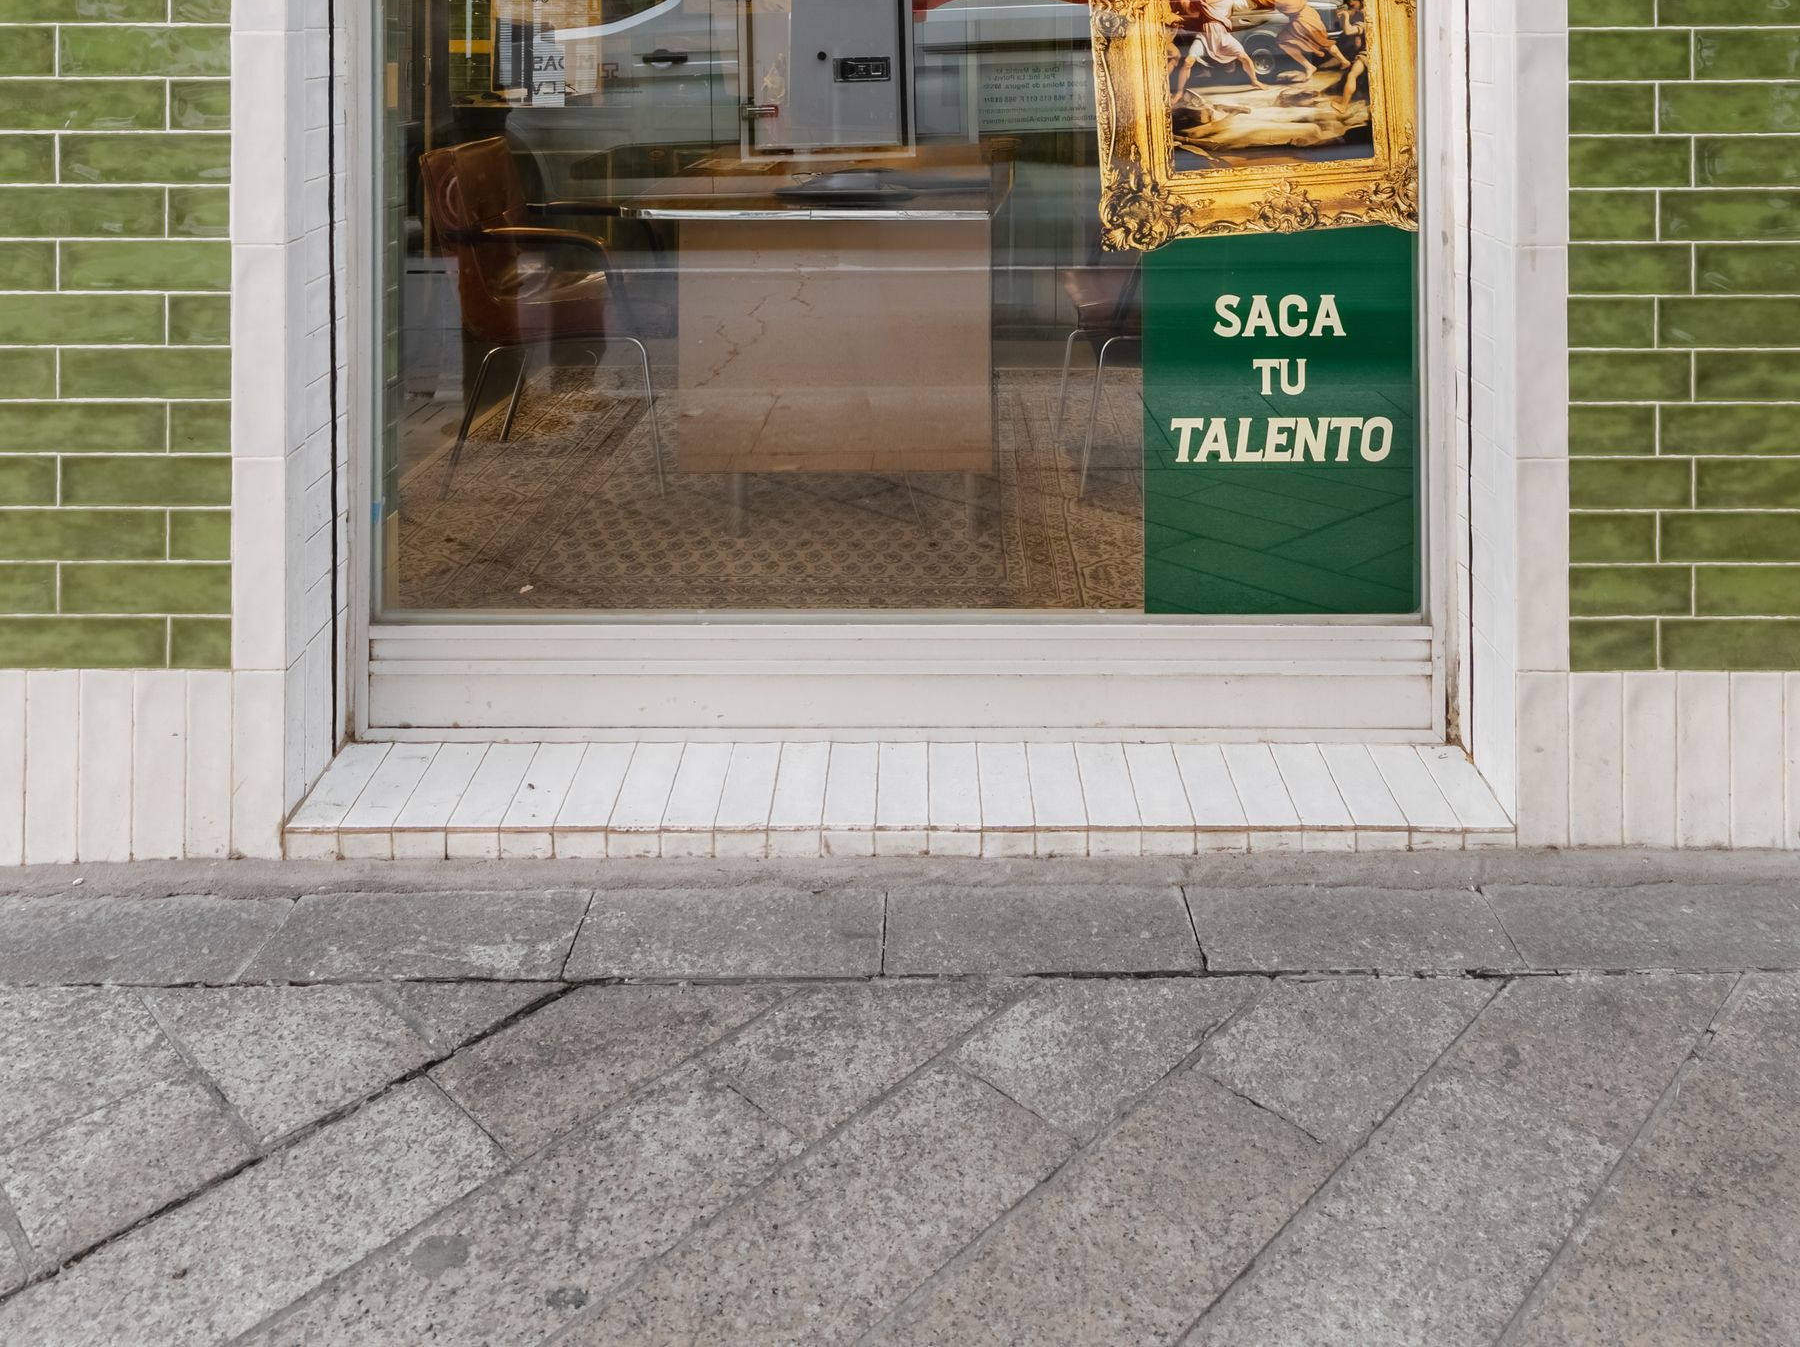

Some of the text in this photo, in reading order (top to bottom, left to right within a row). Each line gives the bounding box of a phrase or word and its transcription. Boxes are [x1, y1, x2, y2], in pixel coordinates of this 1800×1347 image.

[1213, 294, 1346, 338] SACA
[1252, 358, 1307, 396] TU
[1170, 416, 1394, 463] TALENTO
